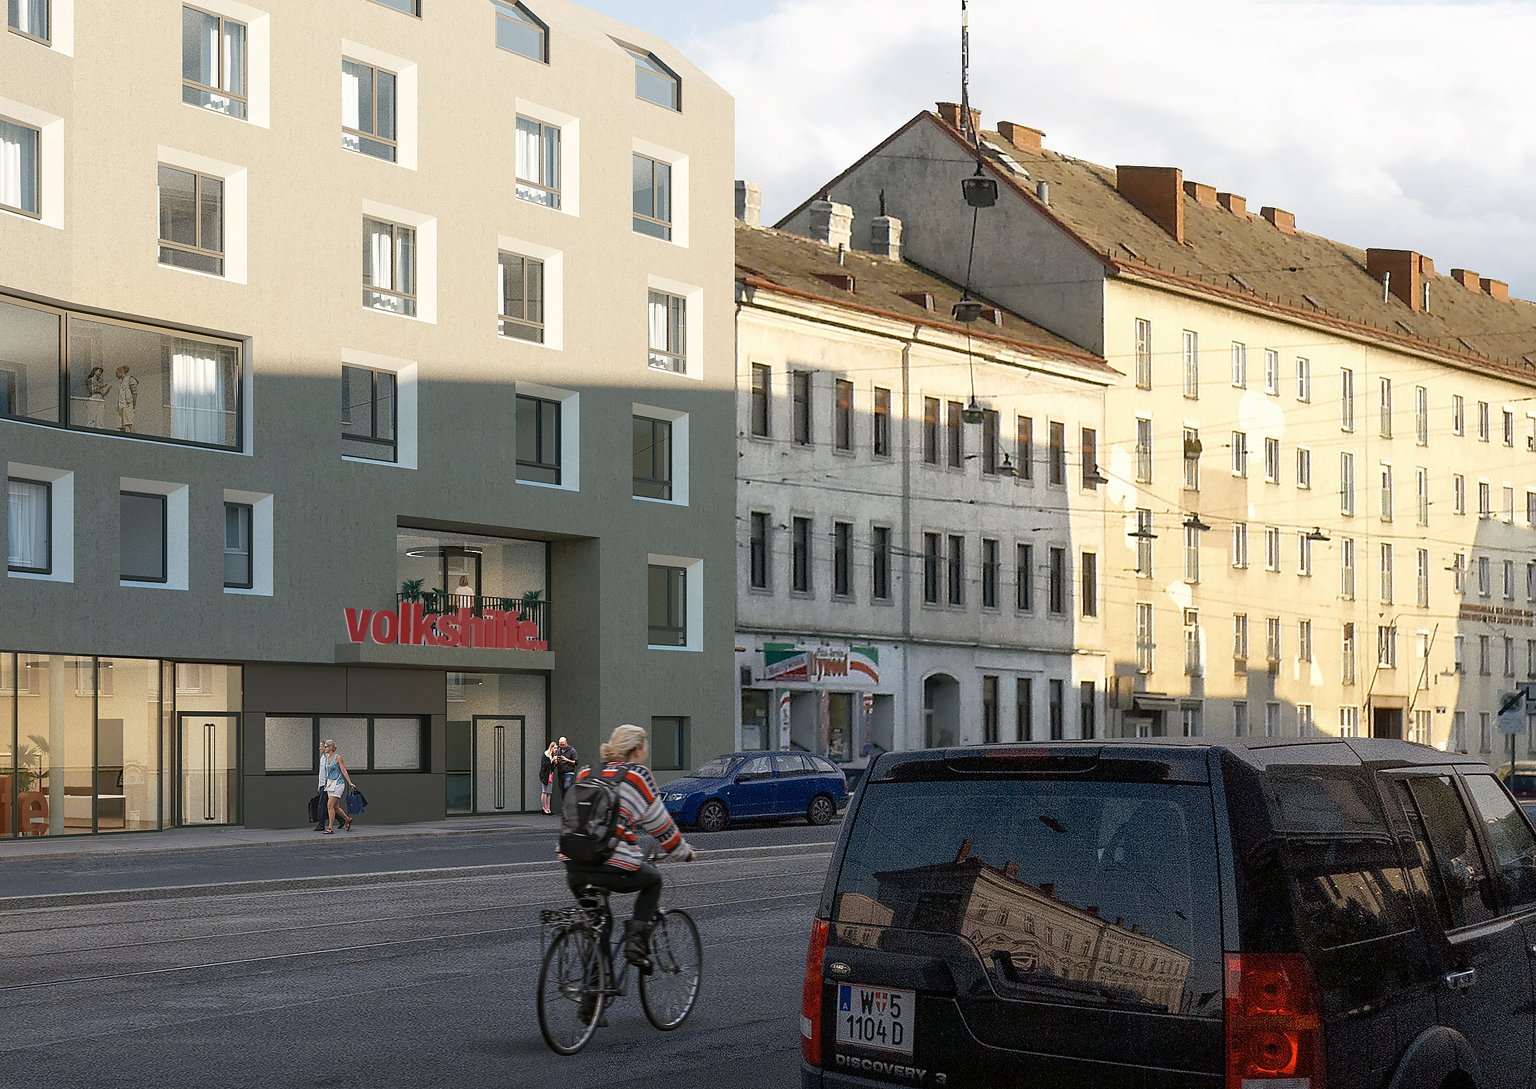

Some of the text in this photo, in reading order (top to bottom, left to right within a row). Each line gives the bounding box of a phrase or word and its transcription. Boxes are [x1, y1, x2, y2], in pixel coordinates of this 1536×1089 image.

[842, 1002, 849, 1010] A
[860, 990, 901, 1018] W 5
[846, 1014, 903, 1045] 1104 D
[835, 1053, 947, 1084] DISCOVERY 3
